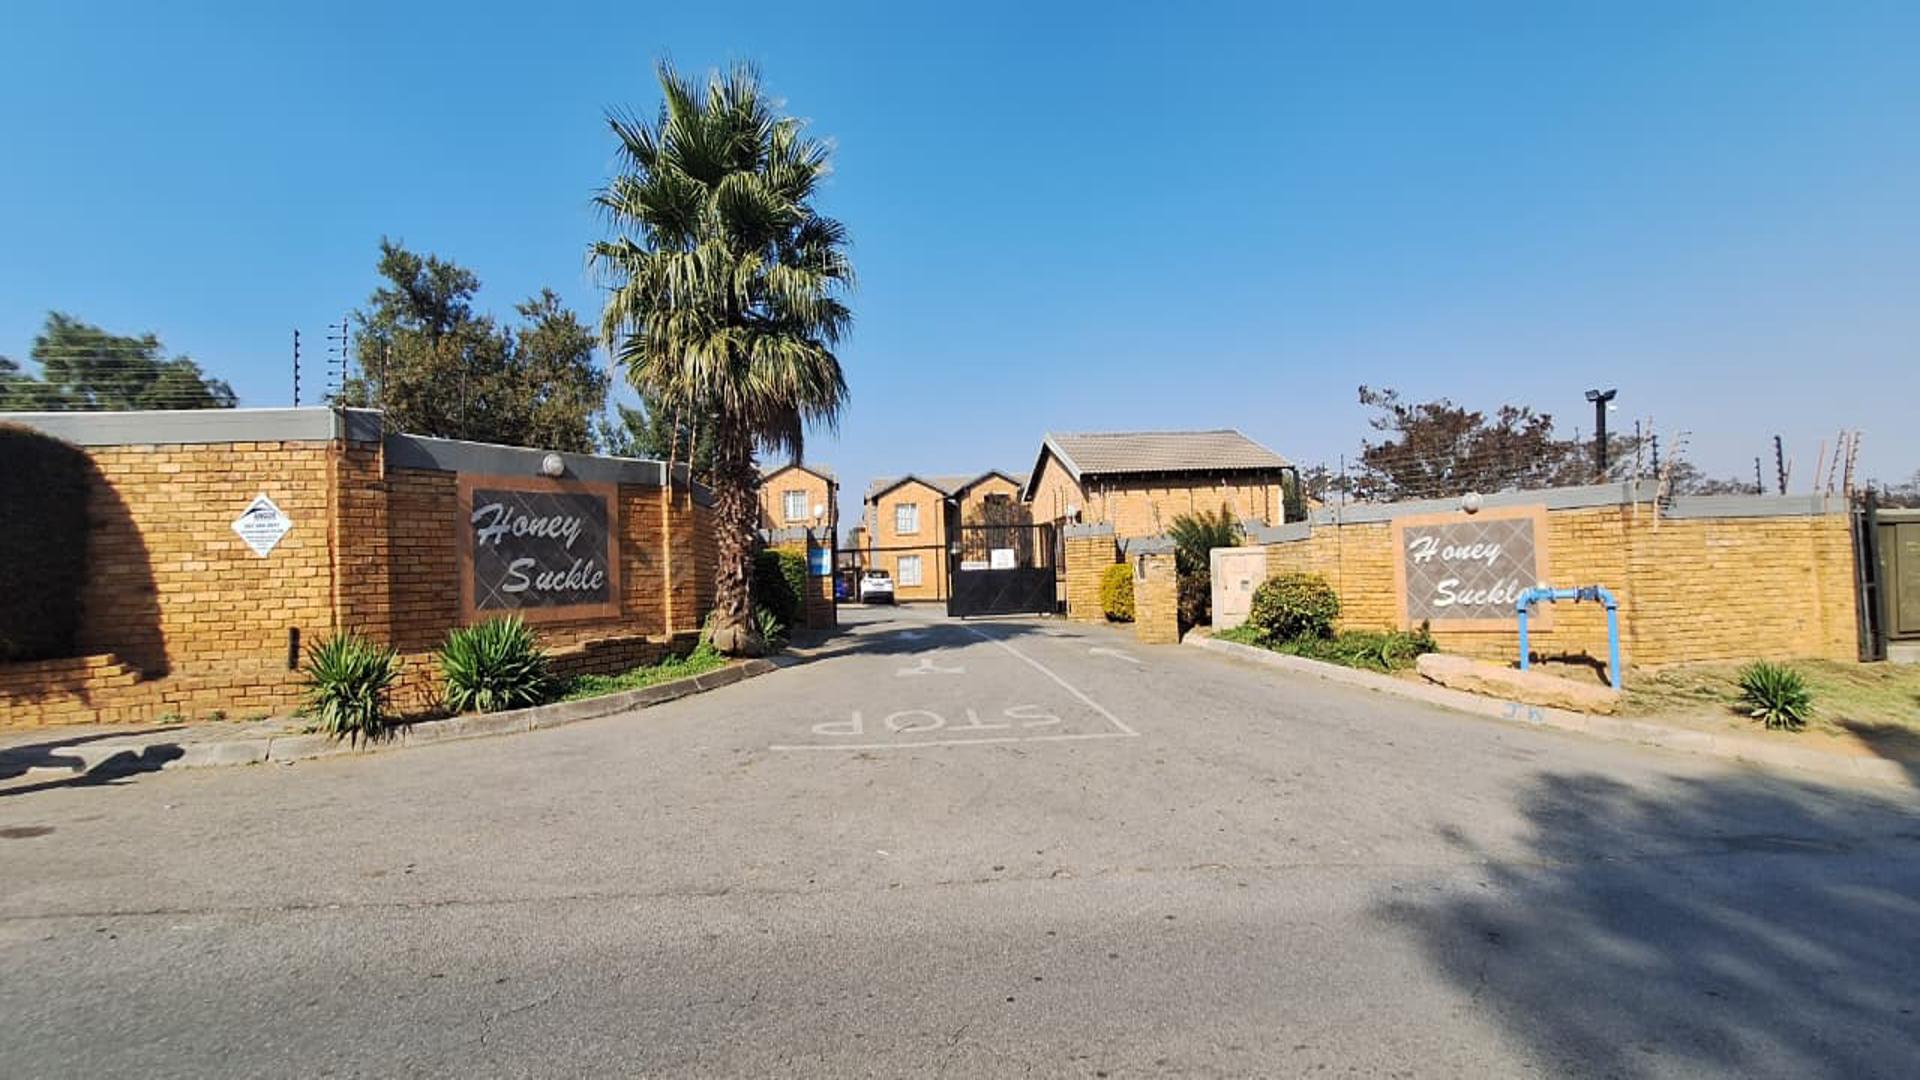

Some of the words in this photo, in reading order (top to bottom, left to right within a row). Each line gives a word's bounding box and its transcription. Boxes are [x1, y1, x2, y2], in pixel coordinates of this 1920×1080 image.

[471, 503, 582, 549] Honey
[1409, 536, 1500, 566] Honey
[502, 558, 603, 592] Suckle
[1433, 578, 1522, 607] Suckl
[811, 703, 1061, 735] STOP
